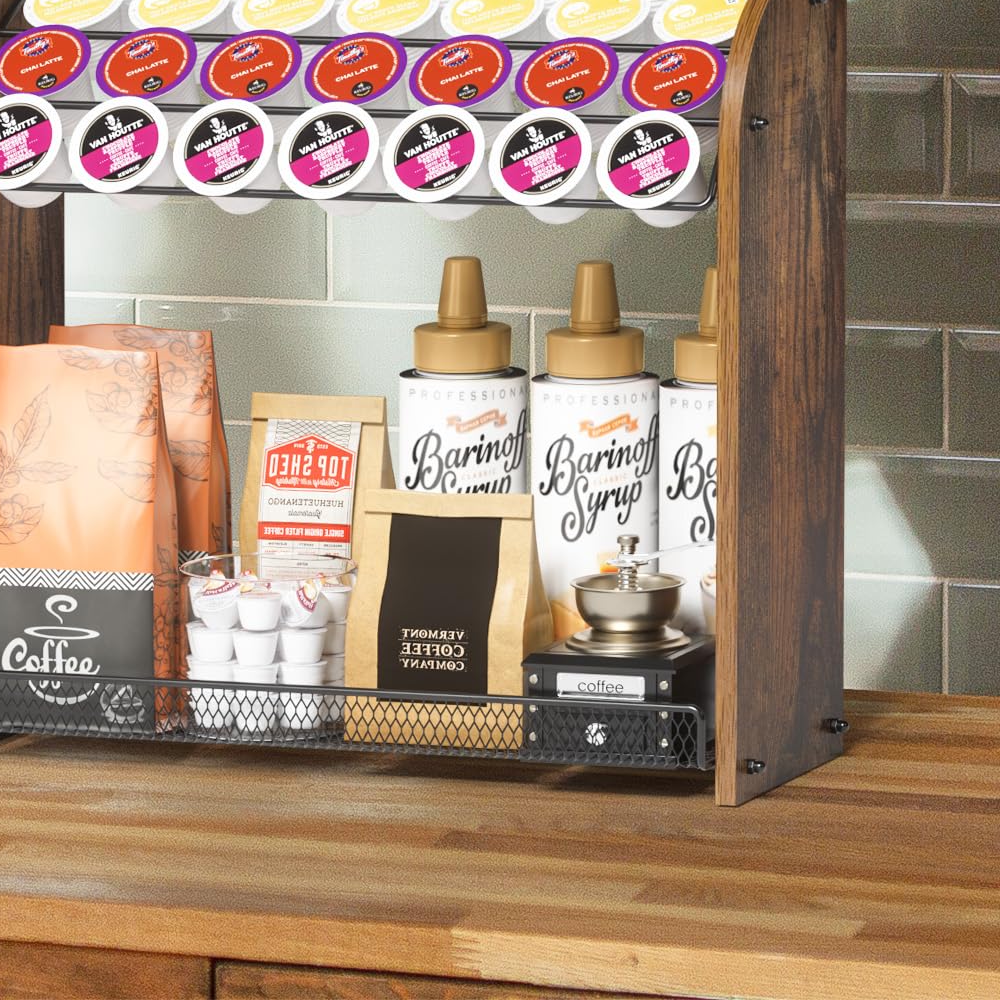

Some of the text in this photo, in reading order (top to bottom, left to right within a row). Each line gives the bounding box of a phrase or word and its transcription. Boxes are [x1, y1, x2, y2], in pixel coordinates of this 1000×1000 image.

[20, 56, 63, 74] CHAI LATTE
[126, 59, 169, 77] CHAI LATTE
[230, 61, 274, 79] CHAI LATTE
[335, 64, 379, 83] CHAI LATTE
[440, 67, 484, 86] CHAI LATTE
[546, 69, 590, 88] CHAI LATTE
[654, 72, 698, 91] CHAI LATTE
[2, 117, 37, 137] HOUTTE
[89, 120, 143, 149] VAN HOUTTE
[193, 123, 248, 152] VAN HOUTTE
[298, 126, 353, 155] VAN HOUTTE
[403, 129, 458, 158] VAN HOUTTE
[509, 131, 565, 161] VAN HOUTTE
[617, 134, 673, 164] VAN HOUTTE
[11, 161, 33, 175] KEURIG
[117, 164, 140, 178] KEURIG
[222, 167, 245, 181] KEURIG
[327, 170, 350, 185] KEURIG
[432, 173, 455, 188] KEURIG
[539, 176, 563, 191] KEURIG
[648, 180, 671, 194] KEURIG
[404, 408, 527, 491] Barinoff
[539, 413, 659, 496] Barinoff
[561, 475, 642, 543] Syrup
[2, 637, 100, 689] Coffee
[577, 681, 624, 694] coffee
